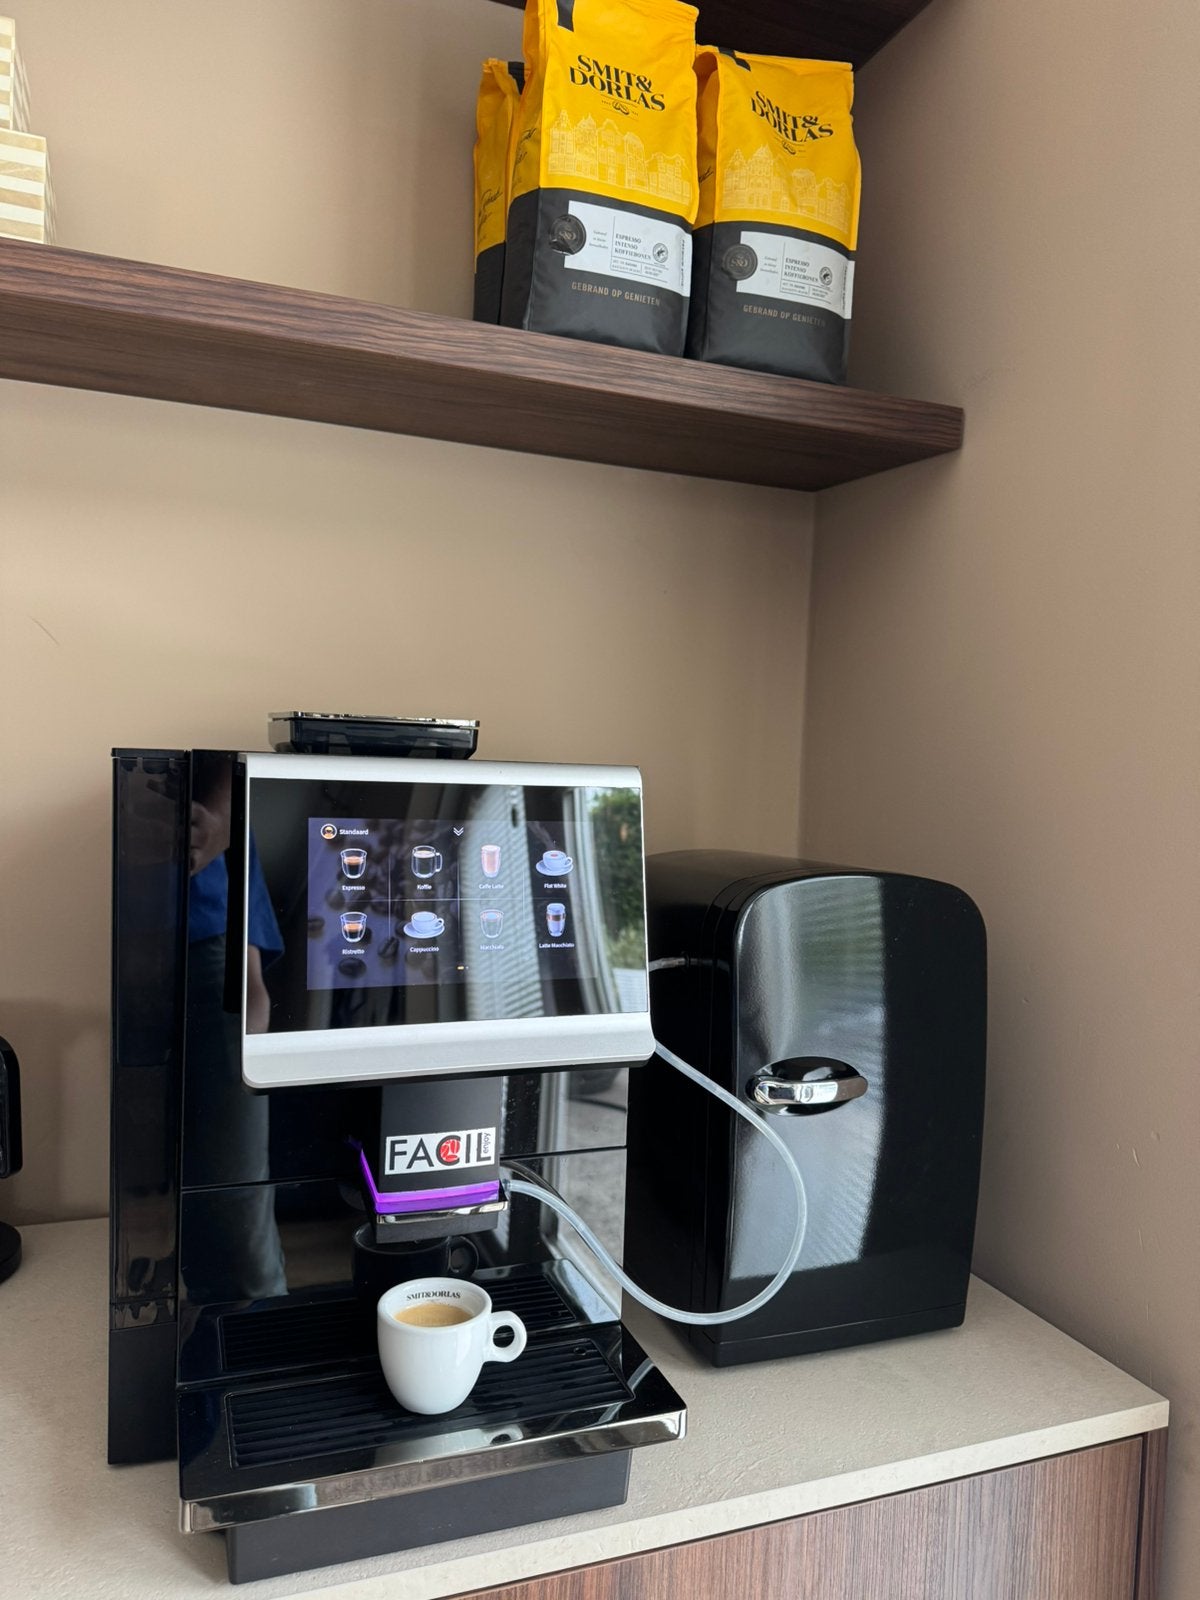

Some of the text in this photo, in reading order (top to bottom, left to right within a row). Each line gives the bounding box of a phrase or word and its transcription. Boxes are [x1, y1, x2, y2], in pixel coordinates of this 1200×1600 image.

[578, 54, 653, 93] SMIT&
[569, 66, 666, 112] DORLAS
[750, 97, 834, 143] DORLAS
[755, 90, 820, 130] SMIT&
[614, 241, 638, 250] INTENSO
[615, 233, 642, 244] ESPRESSO
[571, 281, 660, 306] GEBRAND OP GENIETEN
[743, 304, 779, 317] GEBRAND
[780, 311, 791, 319] OP
[339, 828, 369, 836] Standaard
[409, 946, 440, 954] Cappuccino
[389, 1132, 492, 1171] FACIL
[482, 1132, 492, 1154] enjoy
